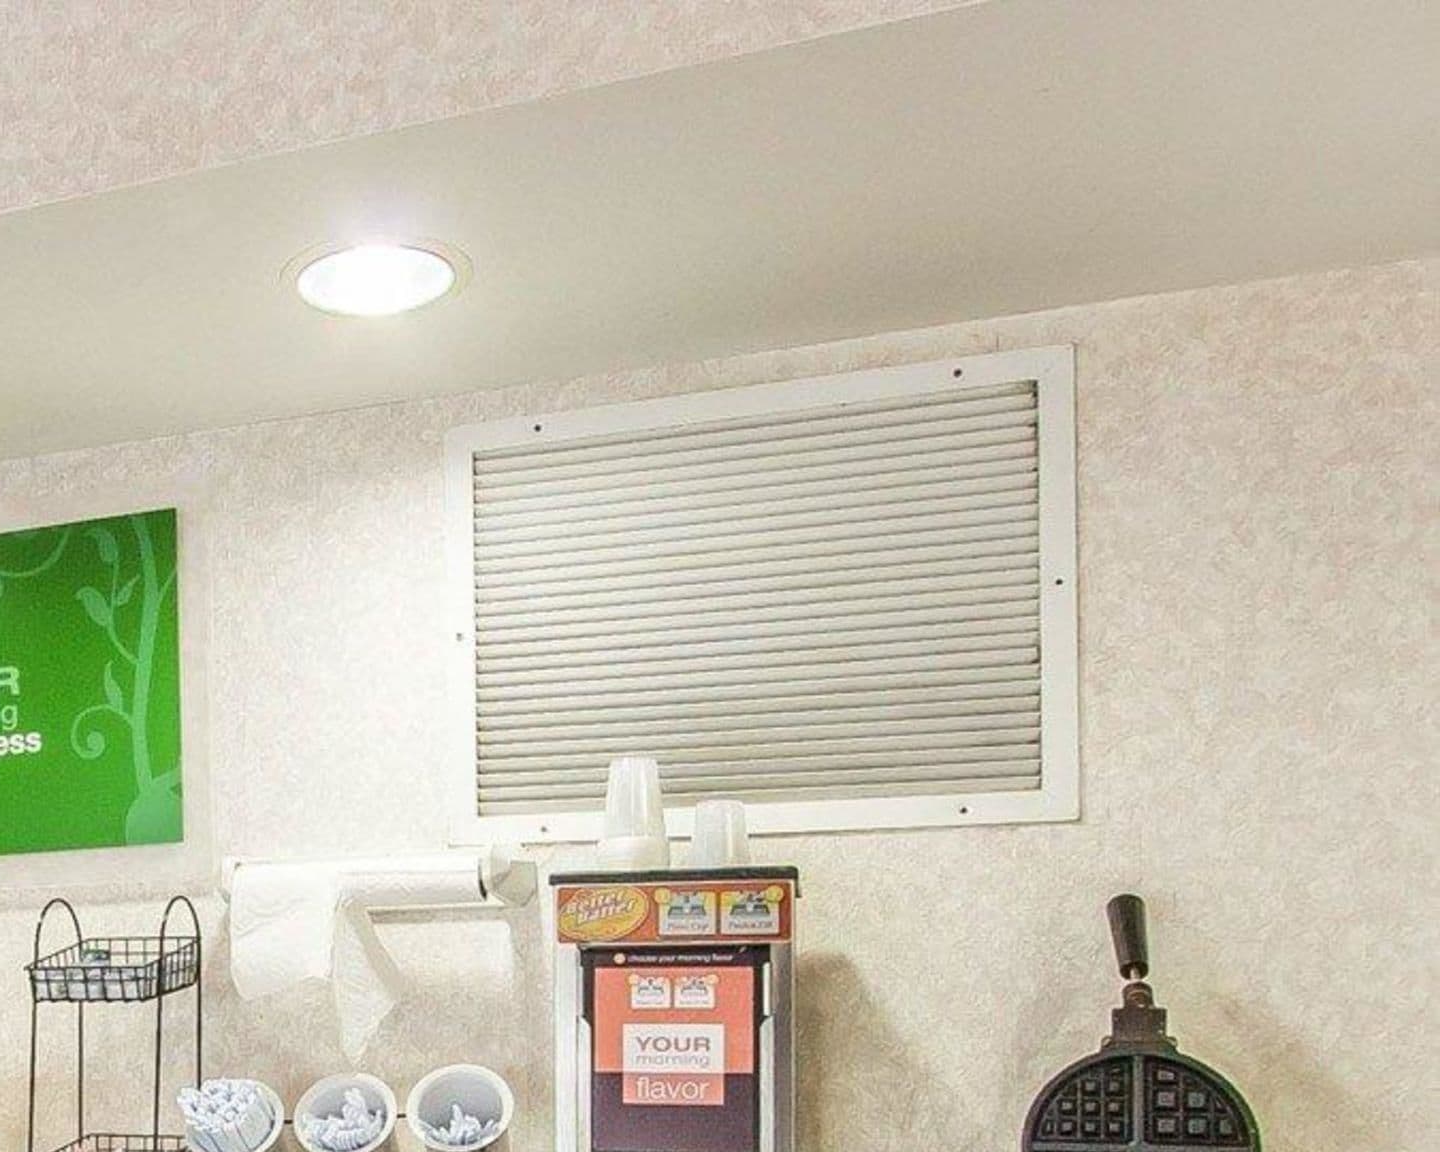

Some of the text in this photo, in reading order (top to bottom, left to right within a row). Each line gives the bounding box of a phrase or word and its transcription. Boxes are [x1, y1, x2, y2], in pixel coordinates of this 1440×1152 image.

[635, 1036, 711, 1052] YOUR
[636, 1053, 709, 1068] morning
[637, 1076, 711, 1100] flavor
